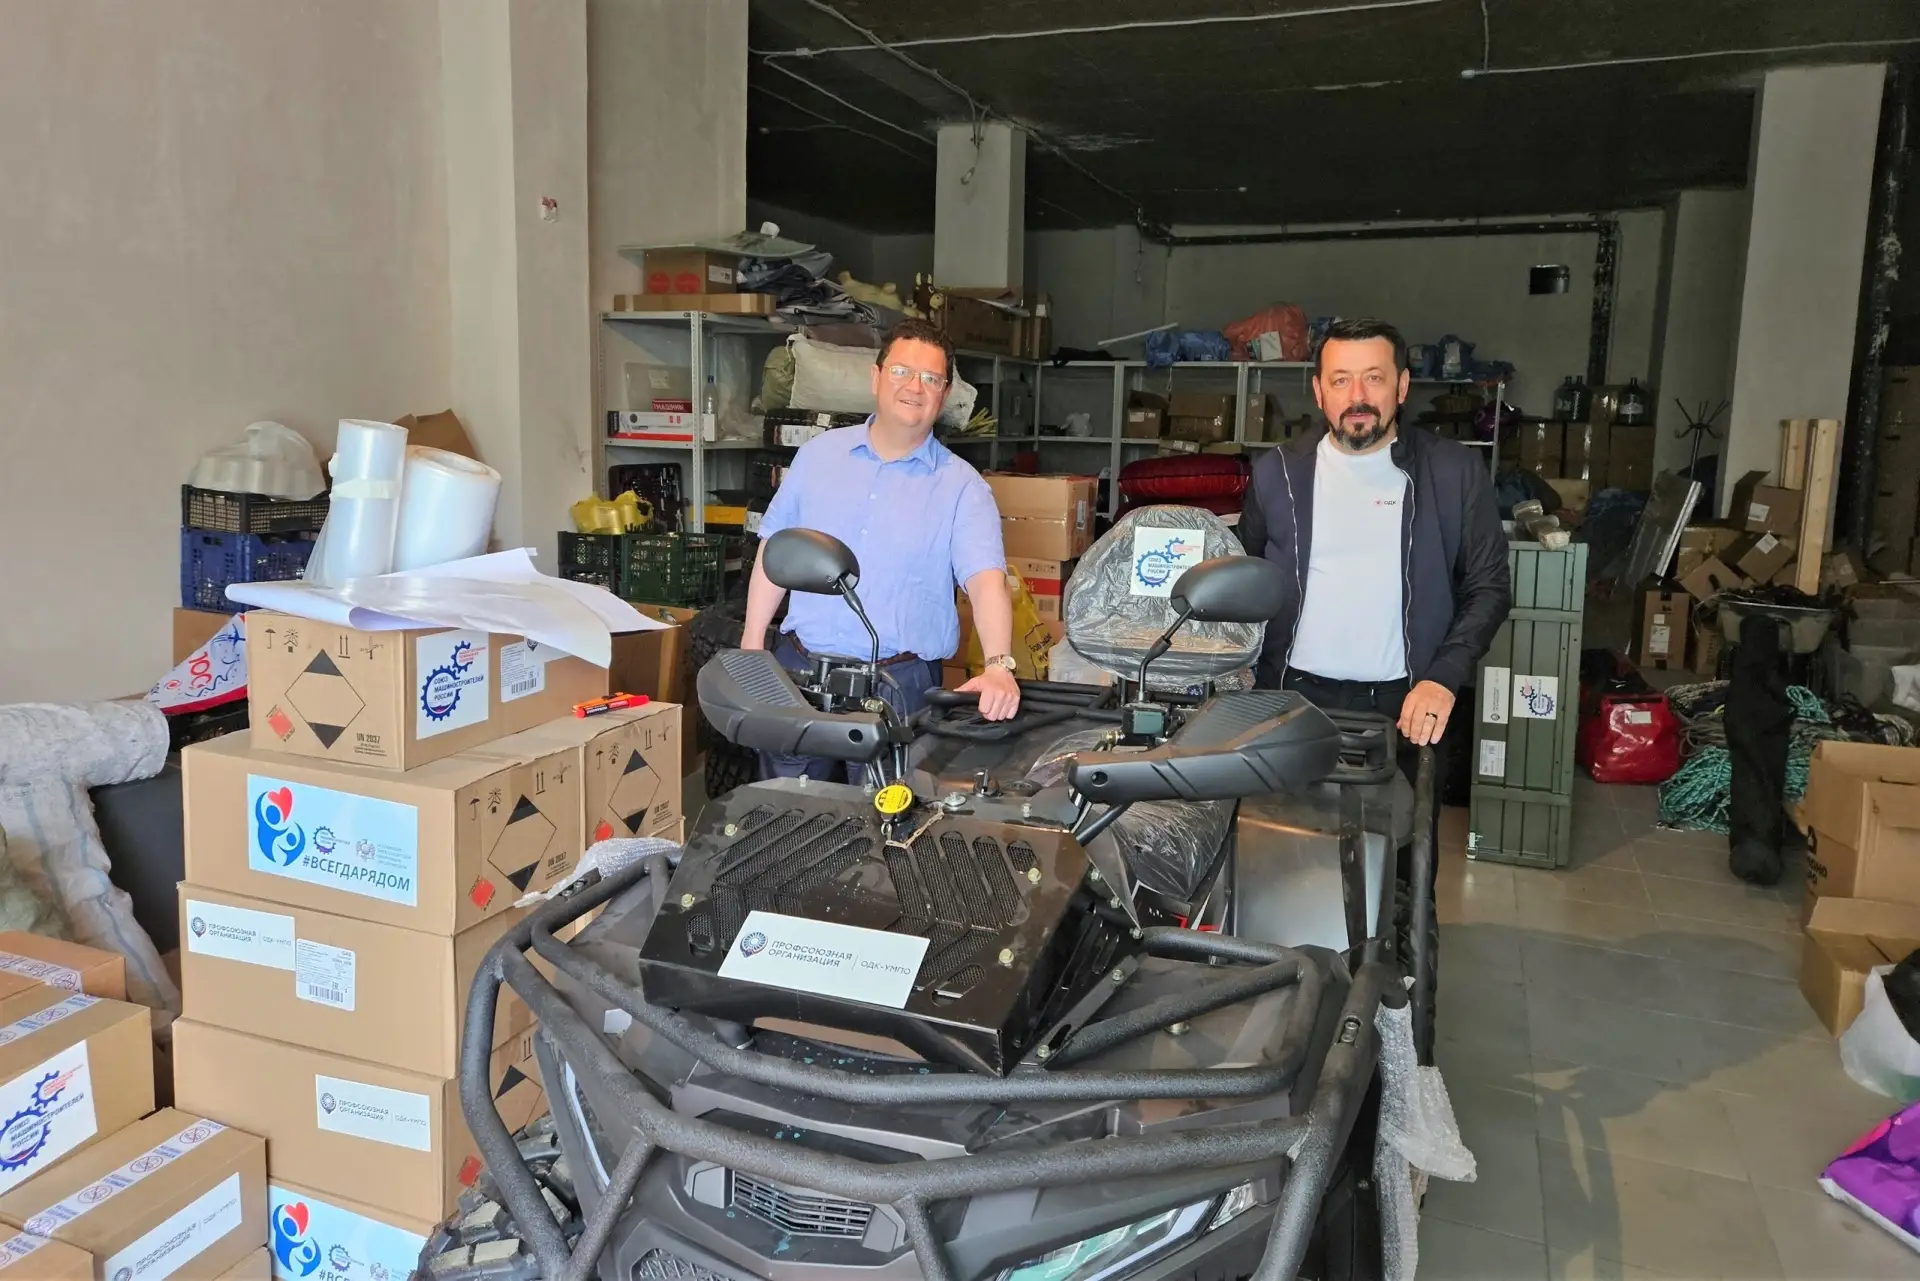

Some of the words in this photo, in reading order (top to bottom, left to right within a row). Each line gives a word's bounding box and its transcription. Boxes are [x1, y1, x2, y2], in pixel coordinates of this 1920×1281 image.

[433, 675, 449, 685] СОЮЗ
[434, 674, 485, 693] МАШИНОСТРОИТЕЛЕЙ
[434, 691, 454, 701] РОССИИ
[356, 733, 365, 741] UN
[303, 854, 411, 892] #ВСЕГДАРЯДОМ
[208, 923, 257, 937] ПРОФСОЮЗНАЯ
[208, 929, 253, 943] ОРГАНИЗАЦИЯ
[768, 949, 841, 968] ОРГАНИЗАЦИЯ
[771, 940, 853, 962] ПРОФСОЮЗНАЯ
[860, 960, 912, 976] ОДК-УМПО
[338, 1099, 389, 1115] ПРОФСОЮЗНАЯ
[339, 1106, 384, 1121] ОРГАНИЗАЦИЯ
[10, 1092, 85, 1141] МАШИНОСТРОИТЕЛЕЙ
[9, 1117, 31, 1135] СОЮЗ
[11, 1129, 40, 1150] РОССИИ
[135, 1222, 197, 1267] ПРОФСОЮЗНАЯ
[135, 1233, 191, 1275] ОРГАНИЗАЦИЯ
